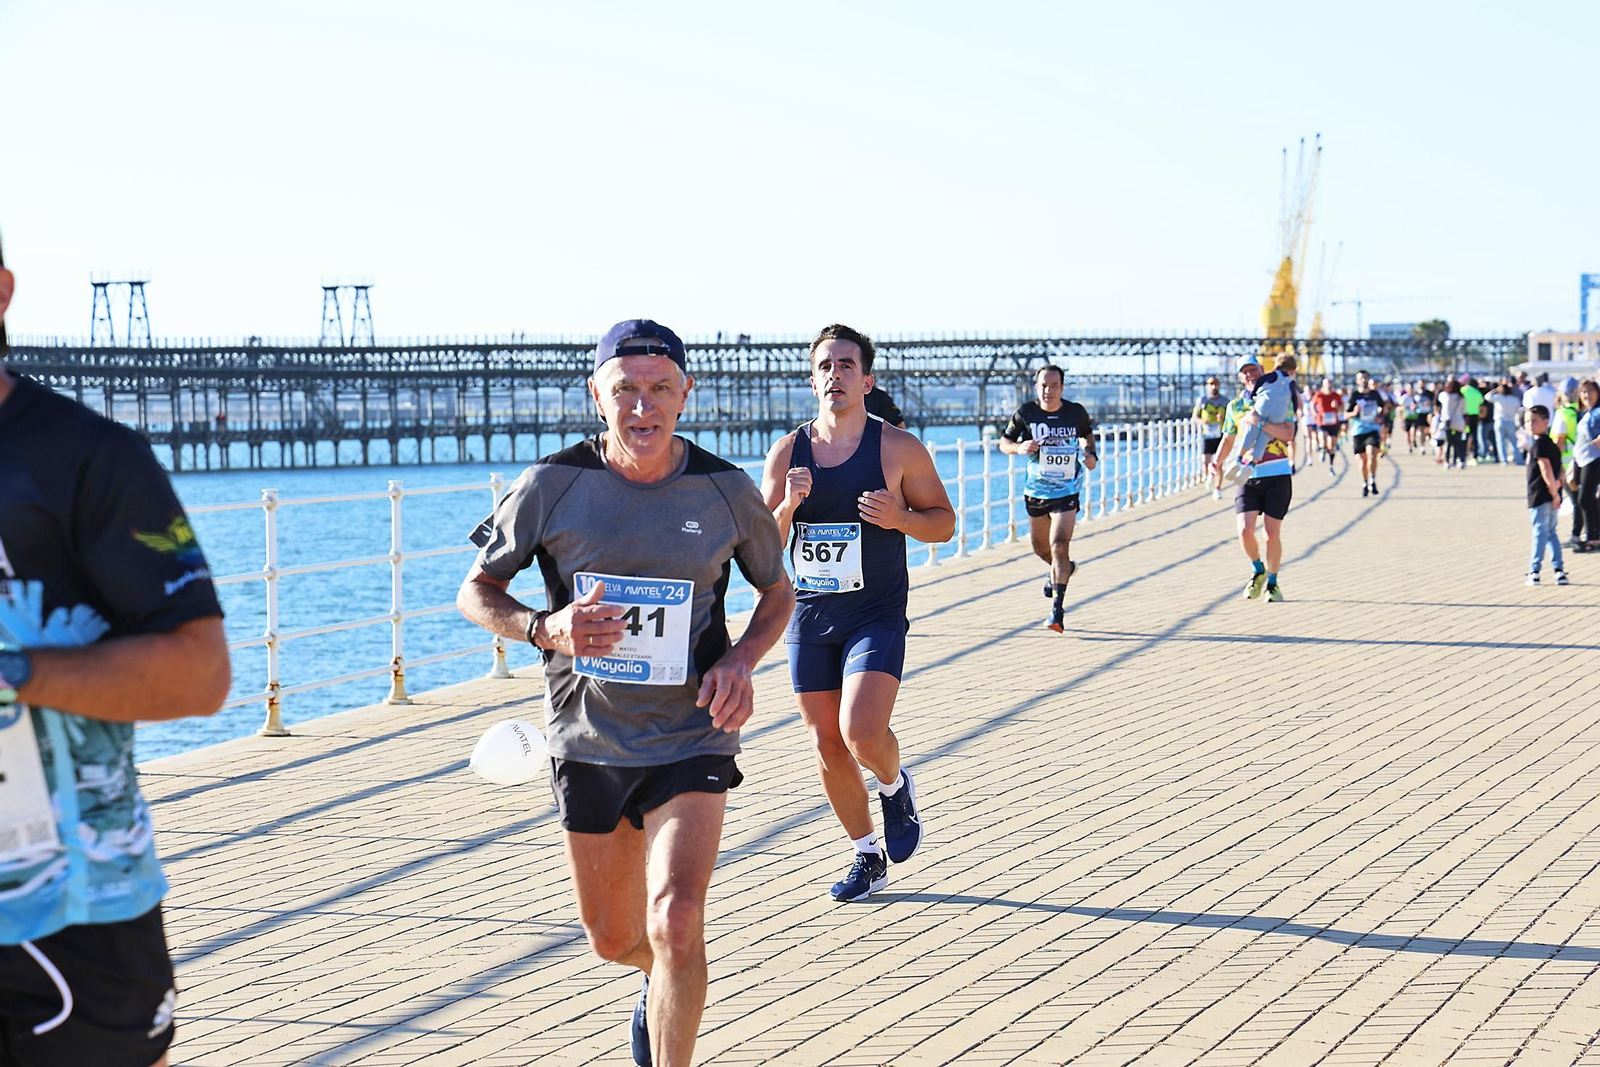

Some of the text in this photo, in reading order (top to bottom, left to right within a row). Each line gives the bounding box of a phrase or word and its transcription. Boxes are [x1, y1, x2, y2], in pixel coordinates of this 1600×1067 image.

[1048, 427, 1076, 437] HUELVA
[1046, 455, 1070, 465] 909
[802, 542, 848, 563] 567
[624, 586, 661, 596] AVATEL
[661, 585, 685, 600] '24
[604, 606, 665, 638] 41
[591, 658, 643, 674] Wayalia
[509, 723, 532, 757] AVATEL
